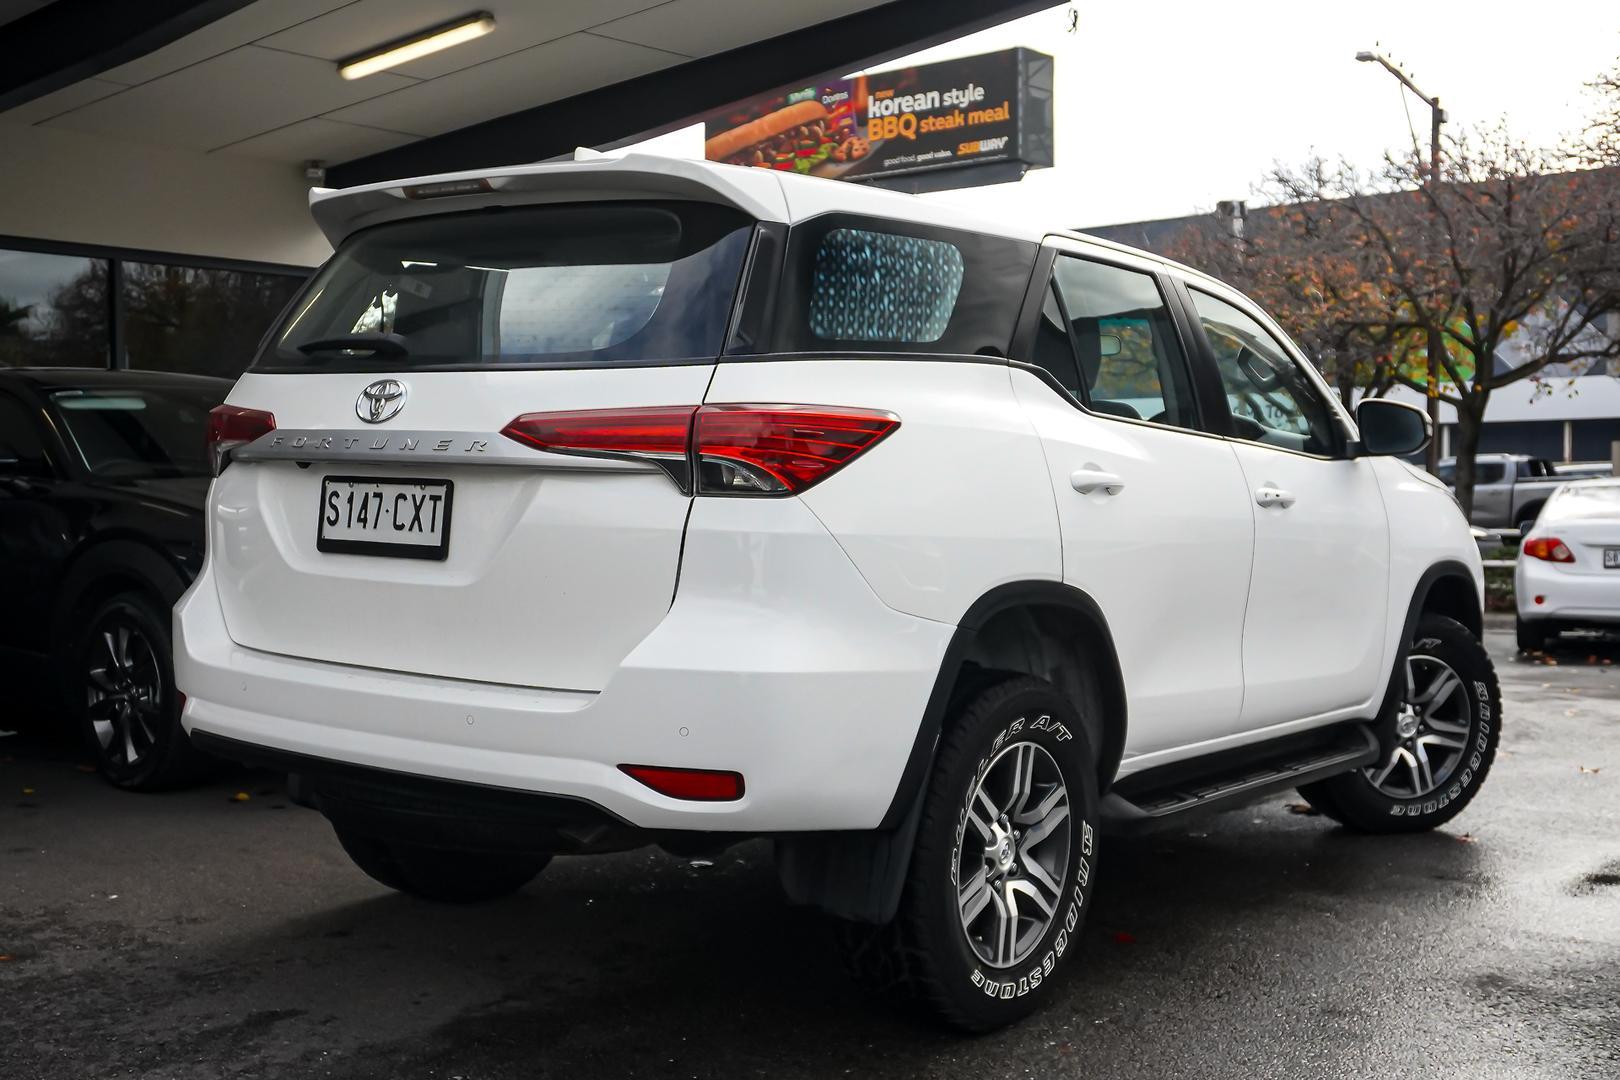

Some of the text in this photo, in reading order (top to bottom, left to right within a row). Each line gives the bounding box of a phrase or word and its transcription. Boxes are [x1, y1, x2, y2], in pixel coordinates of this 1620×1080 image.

[868, 83, 985, 118] korean style
[867, 101, 1010, 141] BBQ steak meal
[270, 436, 490, 452] FORTUNER
[1030, 715, 1073, 742] A/T
[1390, 681, 1490, 816] BRIDGESTONE
[970, 819, 1095, 1000] BRIDGESTONE
